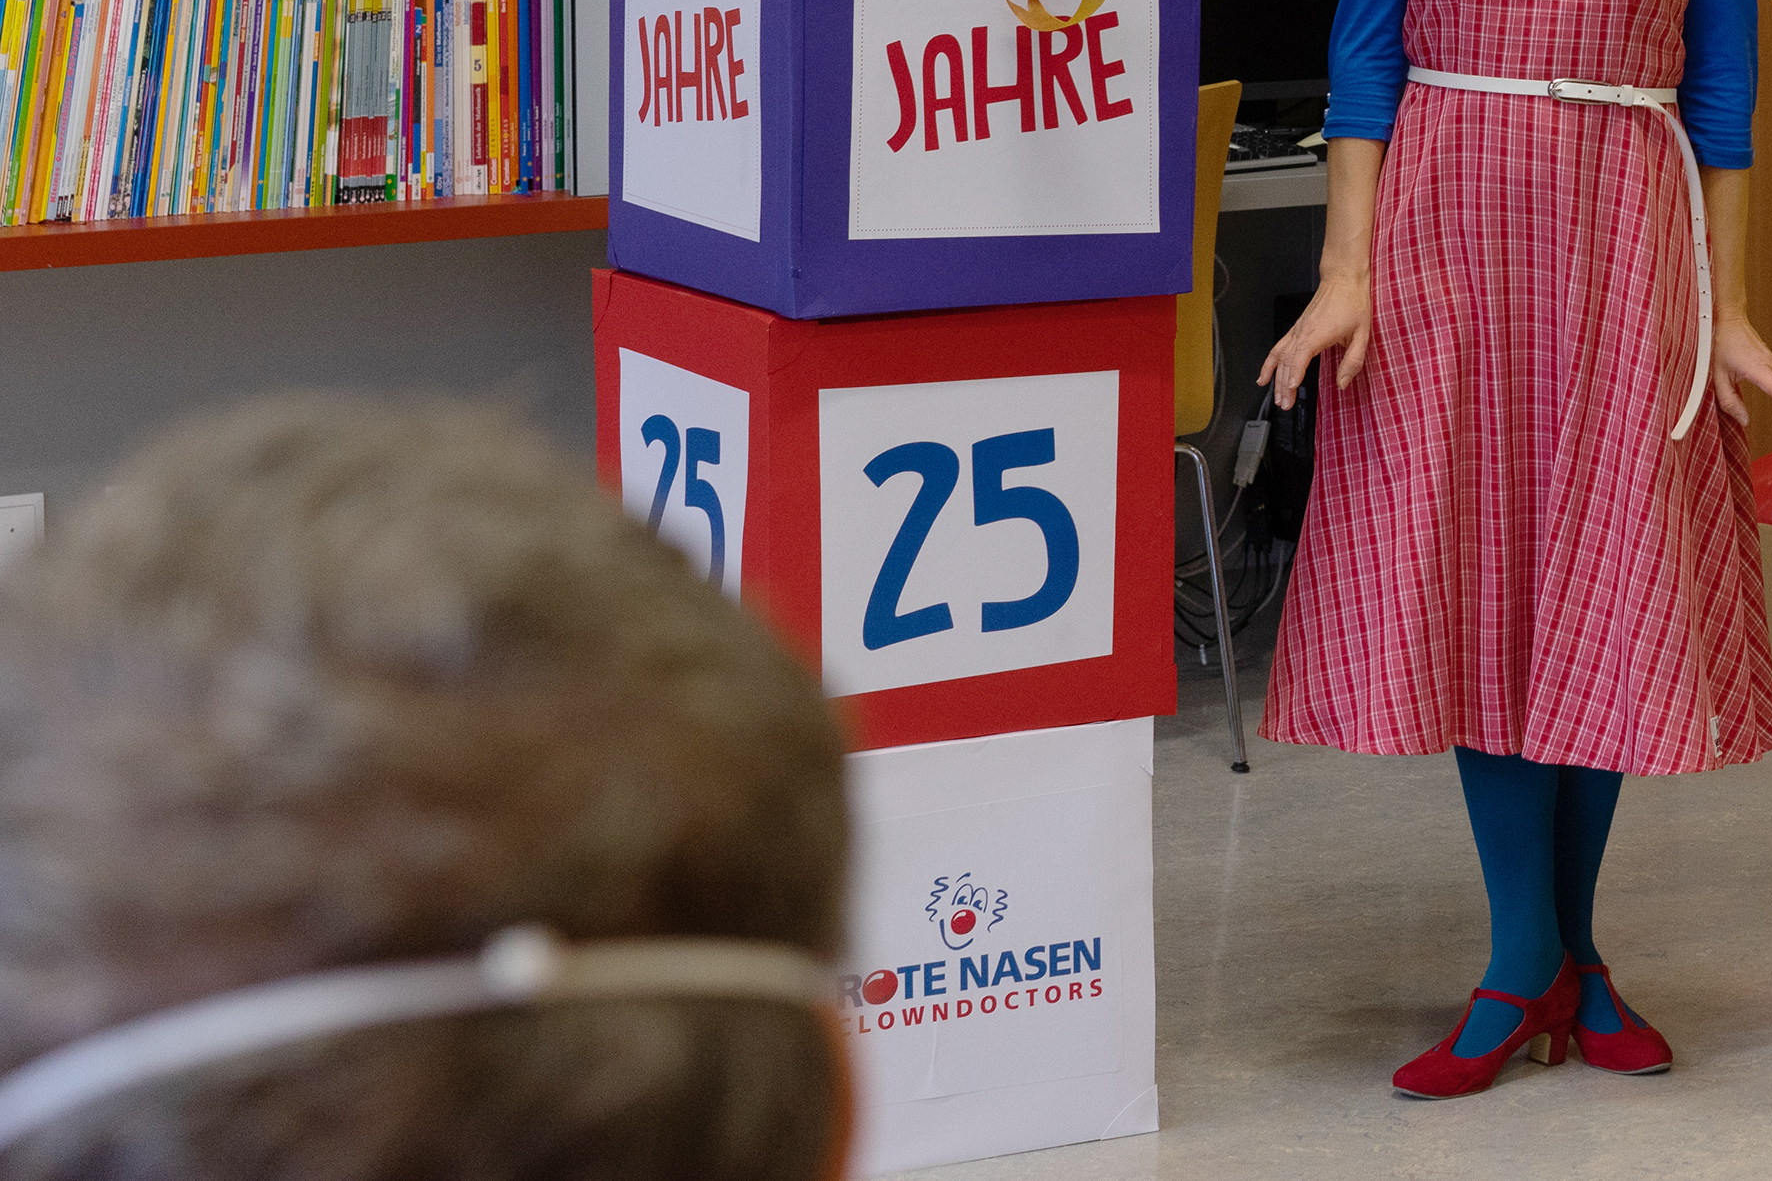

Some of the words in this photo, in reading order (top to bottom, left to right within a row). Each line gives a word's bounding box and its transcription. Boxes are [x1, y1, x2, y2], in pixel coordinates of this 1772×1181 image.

[474, 59, 482, 72] 5
[637, 7, 750, 127] JAHRE
[886, 11, 1134, 153] JAHRE
[640, 414, 726, 601] 25
[862, 427, 1080, 651] 25
[959, 936, 1101, 992] NASEN
